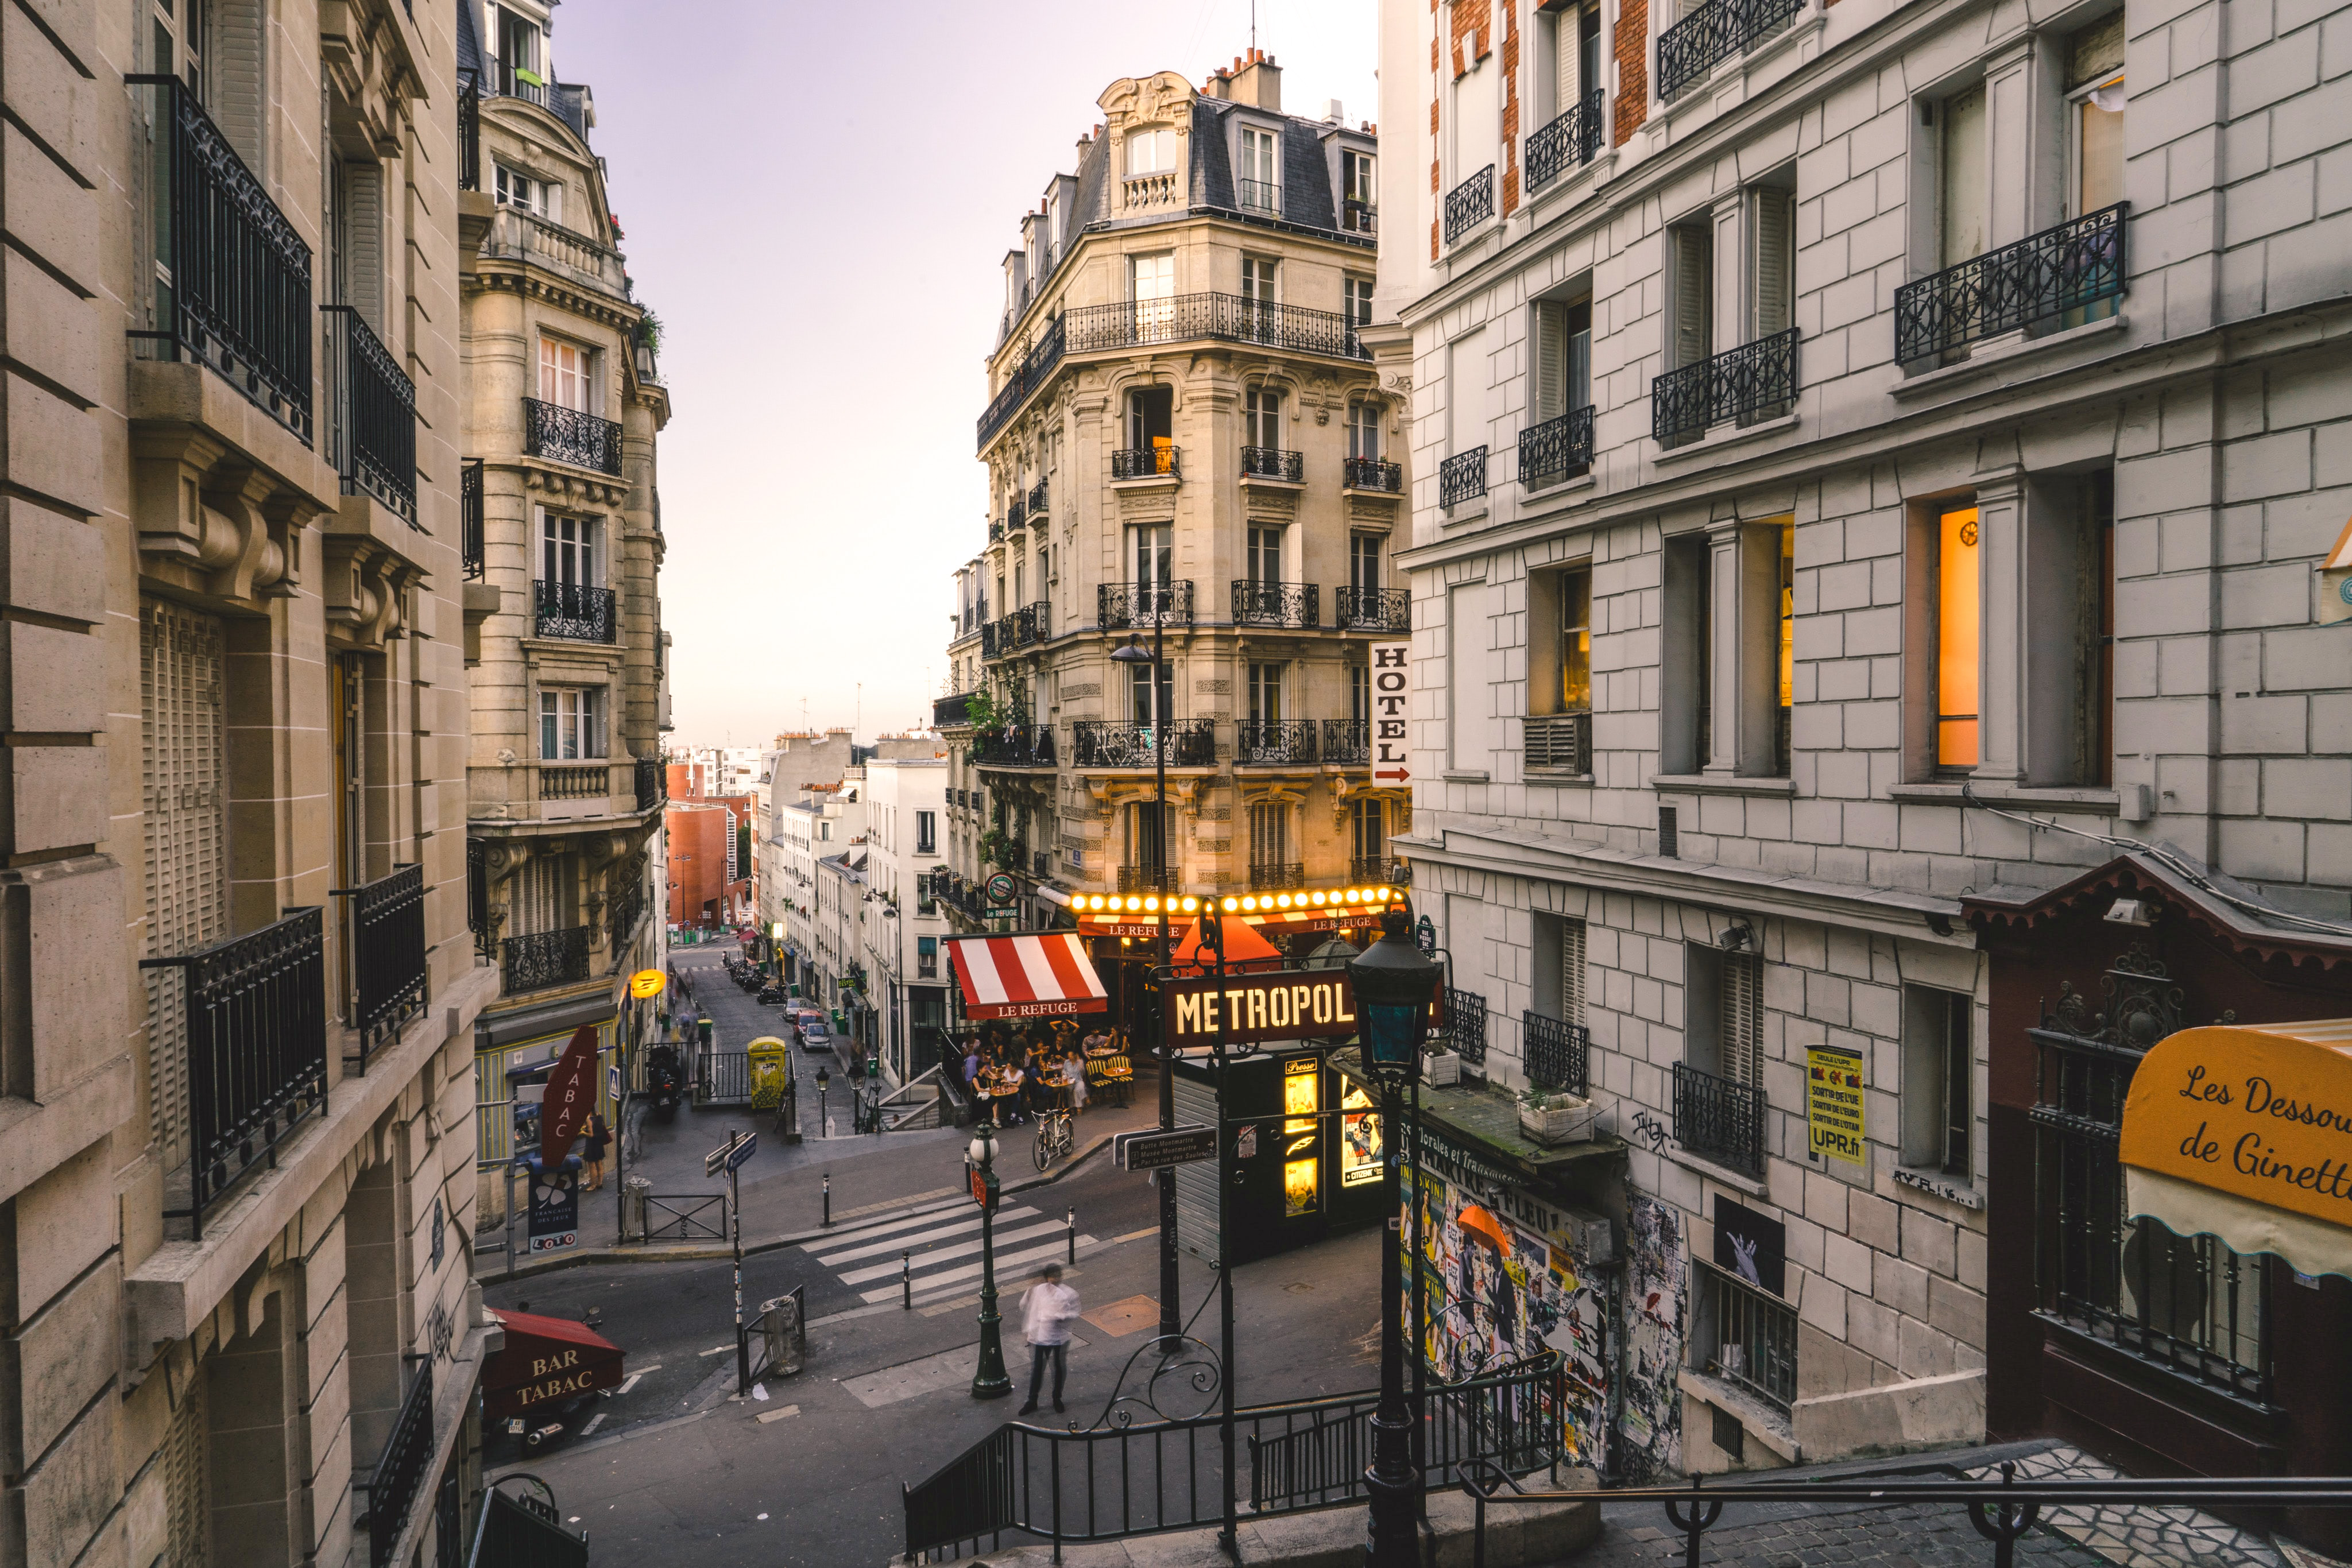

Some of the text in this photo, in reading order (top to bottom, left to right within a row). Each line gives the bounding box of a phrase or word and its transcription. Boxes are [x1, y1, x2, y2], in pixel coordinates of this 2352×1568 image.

[1375, 648, 1407, 762] HOTEL
[995, 909, 1018, 917] REFUGE
[1109, 926, 1125, 935] LE
[1314, 920, 1327, 930] LE
[1419, 934, 1432, 943] PIERRE
[998, 1002, 1077, 1017] LE REFUGE
[1175, 982, 1355, 1035] METROPOL
[1287, 1062, 1315, 1073] Presse
[1817, 1054, 1850, 1066] SEULE L'UPR
[556, 1055, 586, 1137] TABAC
[1812, 1086, 1859, 1105] SORTIR DE L'UE
[2179, 1065, 2352, 1134] Les Dessou
[1812, 1099, 1859, 1118] SORTIR DE L'EURO
[1813, 1113, 1859, 1132] SORTIR DE L'OTAN
[1140, 1144, 1197, 1158] Musée Montmartre
[1159, 1137, 1194, 1147] Montmartre
[1418, 1126, 1448, 1157] lorales
[1451, 1149, 1460, 1164] et
[1813, 1127, 1860, 1156] UPR.fr
[2179, 1121, 2221, 1163] de
[533, 1233, 575, 1250] LOTO
[532, 1350, 579, 1377] BAR
[517, 1370, 593, 1406] TABAC
